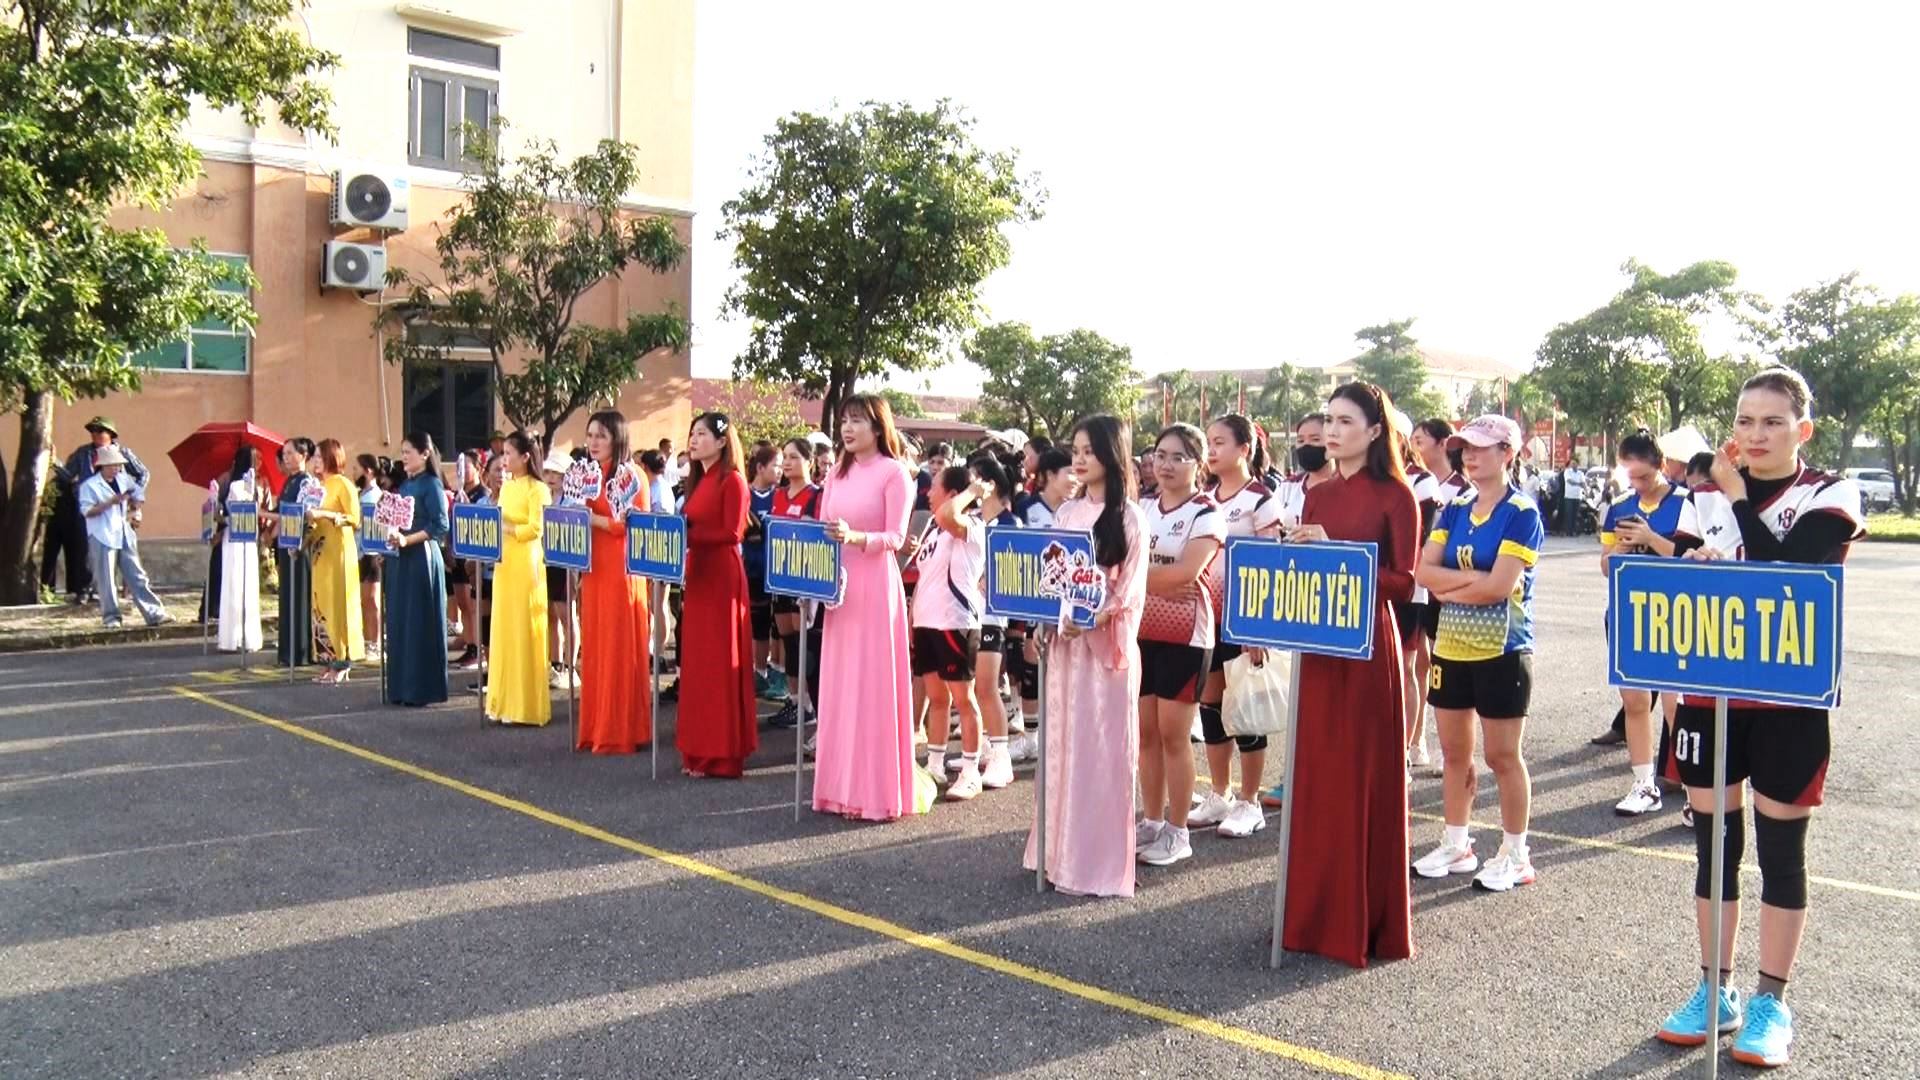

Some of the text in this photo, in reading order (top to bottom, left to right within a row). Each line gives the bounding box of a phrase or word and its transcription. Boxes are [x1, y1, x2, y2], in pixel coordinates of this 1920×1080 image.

[547, 521, 559, 551] TDP
[631, 528, 644, 560] TDP
[669, 529, 681, 573] LỢI
[772, 538, 786, 575] TDP
[787, 532, 802, 577] TÂN
[995, 540, 1023, 597] TRƯỜNG
[1238, 558, 1362, 629] TDP ĐÔNG YÊN
[1629, 586, 1815, 670] TRỌNG TÀI
[1675, 727, 1701, 765] 01
